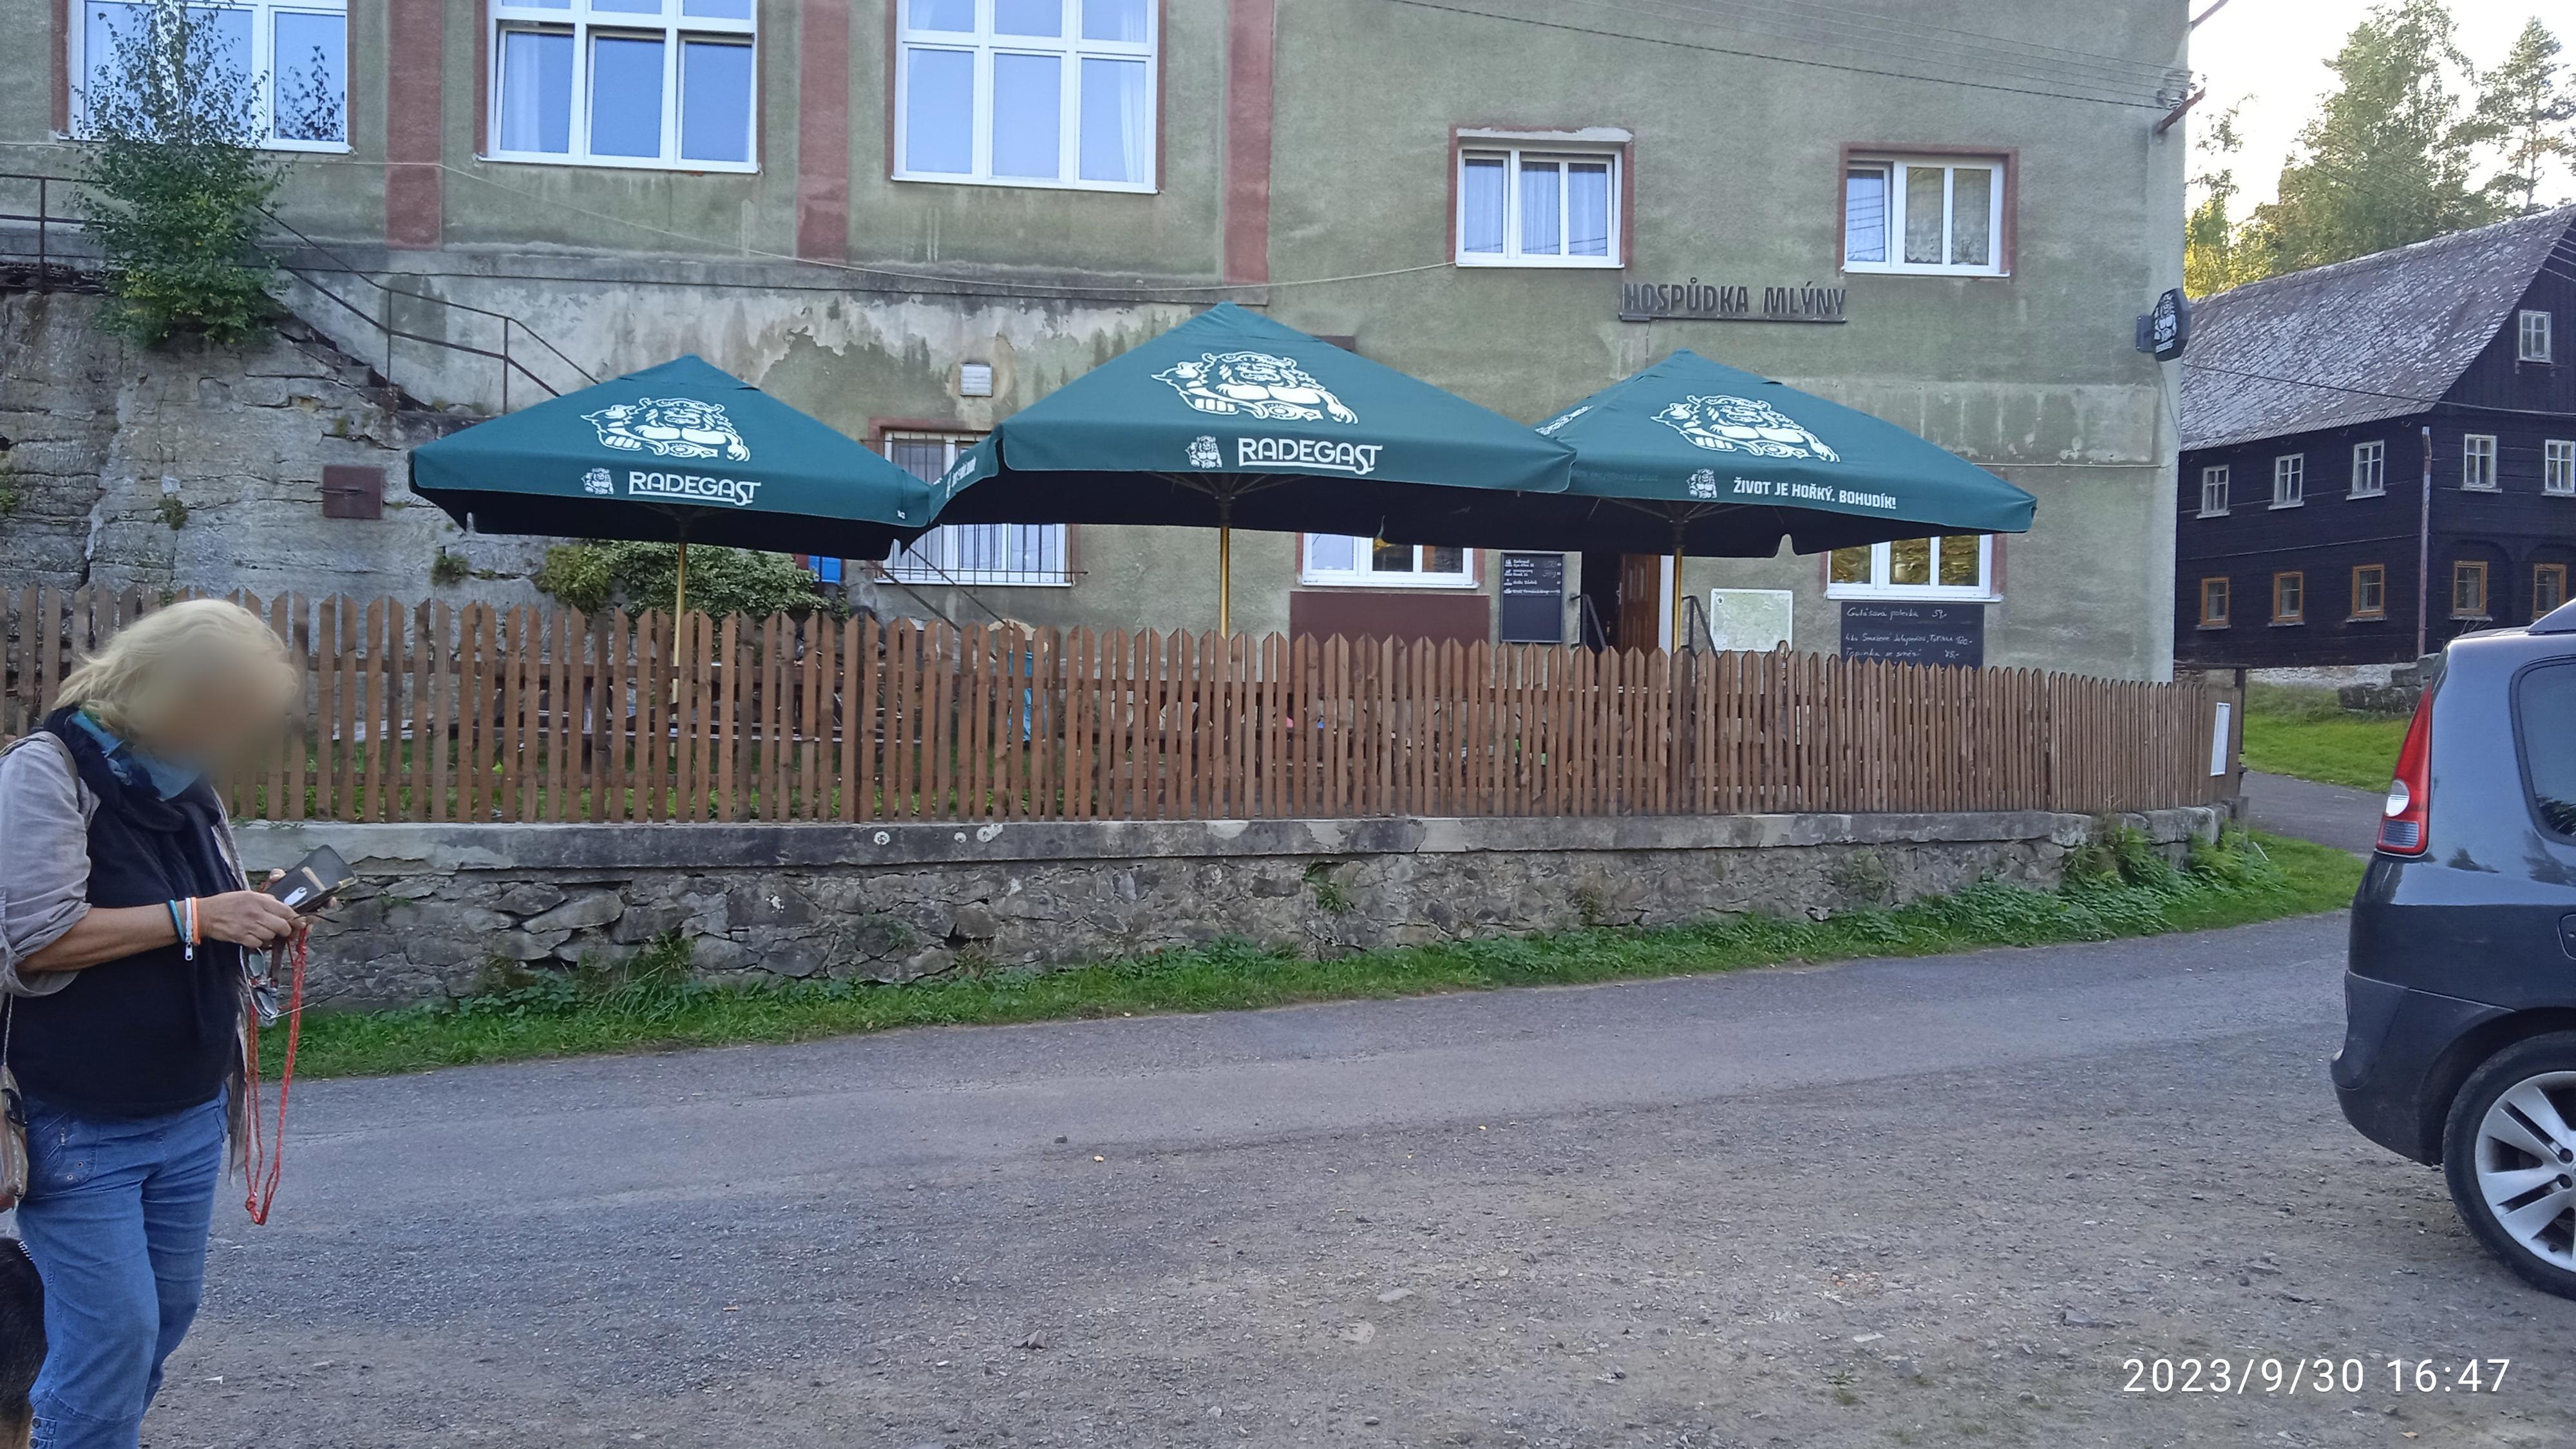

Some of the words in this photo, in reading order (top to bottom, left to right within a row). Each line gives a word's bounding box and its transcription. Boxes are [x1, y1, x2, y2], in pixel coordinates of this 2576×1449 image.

[1622, 277, 1749, 313] HOSPŮDKA
[1762, 281, 1846, 315] MLÝNY
[1238, 437, 1383, 475] RADEGAST
[629, 471, 762, 506] RADEGAST
[1733, 477, 1771, 495] ŽIVOT
[1774, 482, 1789, 496] JE
[1792, 483, 1835, 502] HOŘKÝ.
[1839, 489, 1897, 509] BOHUDÍK!
